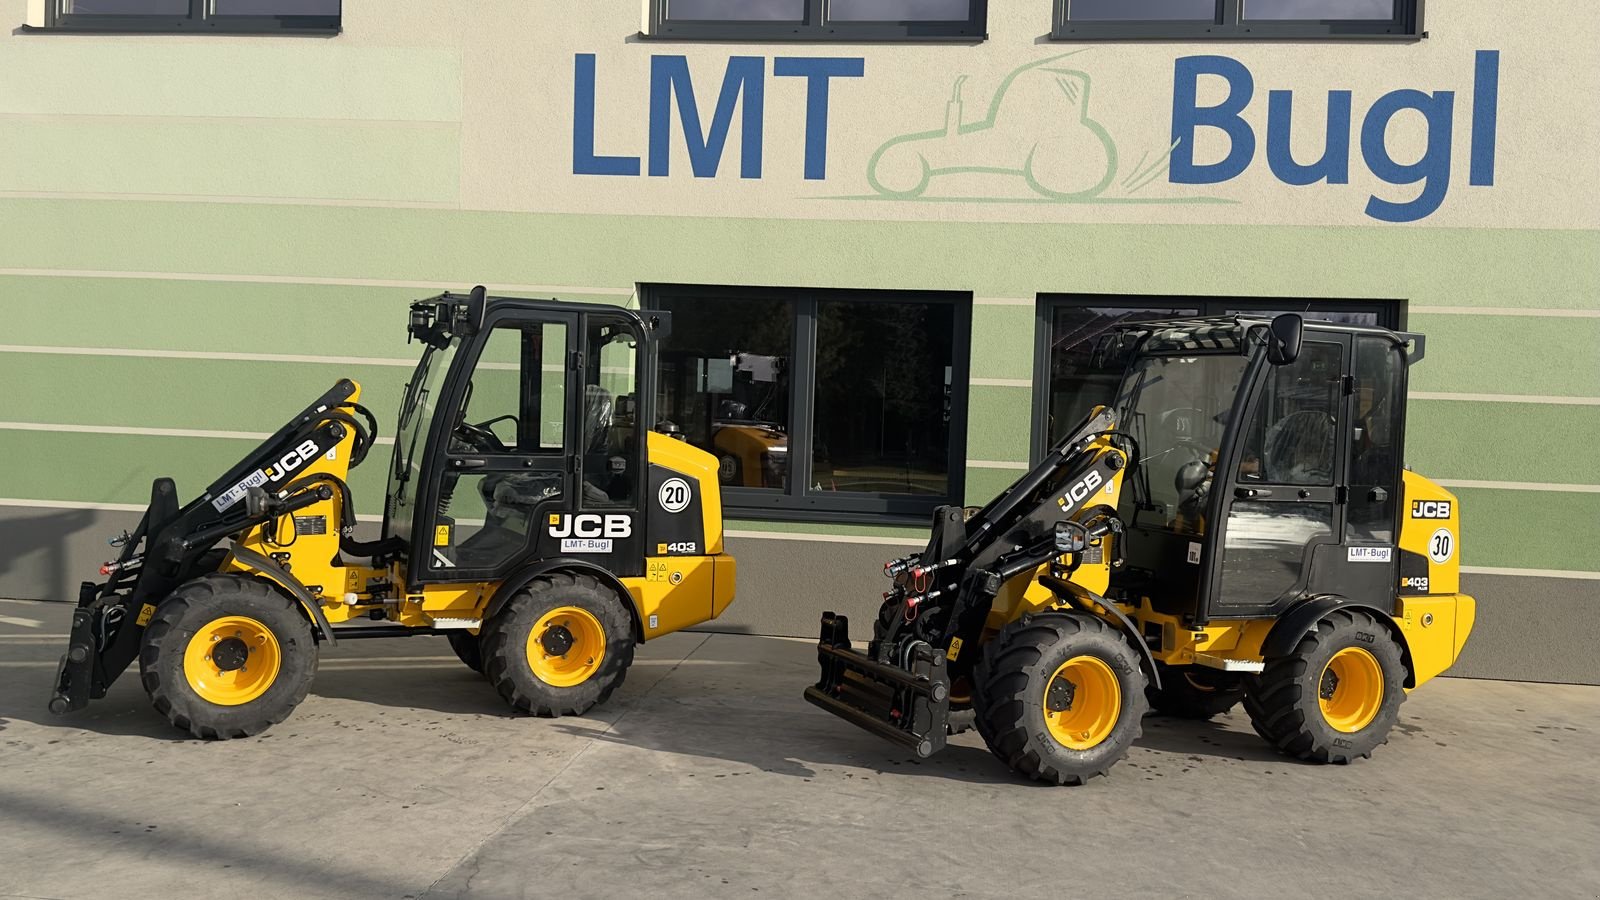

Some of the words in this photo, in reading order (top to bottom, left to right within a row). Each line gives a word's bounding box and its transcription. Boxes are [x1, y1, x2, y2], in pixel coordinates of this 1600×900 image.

[573, 53, 864, 180] LMT
[1169, 49, 1500, 222] Bugl
[266, 439, 319, 482] JCB
[665, 486, 684, 504] 20
[1059, 470, 1102, 512] JCB
[1412, 501, 1450, 518] JCB
[549, 513, 632, 538] JCB
[667, 542, 697, 552] 403
[1350, 548, 1389, 559] LMT-Bugl
[1432, 534, 1450, 557] 30
[1407, 577, 1428, 587] 403
